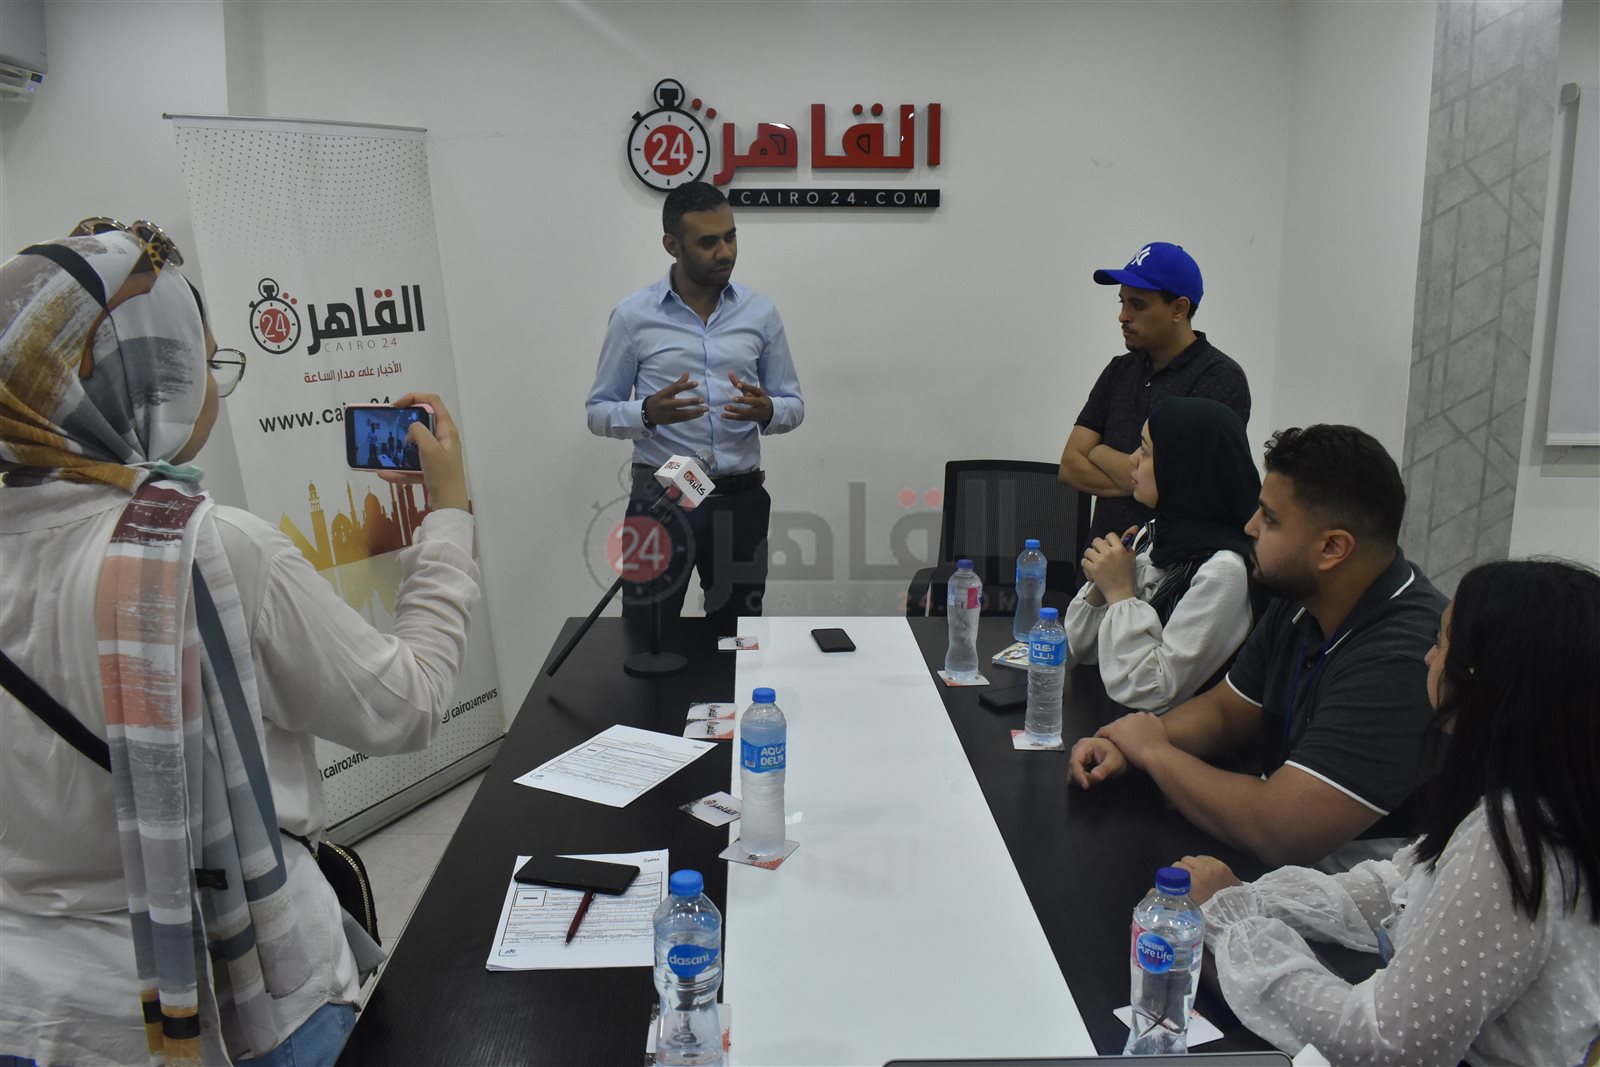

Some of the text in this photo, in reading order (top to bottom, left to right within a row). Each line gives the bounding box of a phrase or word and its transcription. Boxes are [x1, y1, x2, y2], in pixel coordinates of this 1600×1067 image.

[651, 132, 688, 166] 24
[740, 191, 928, 205] CAIRO24.COM
[261, 313, 287, 338] 24
[324, 336, 397, 353] CAIRO 24
[303, 361, 402, 383] الأخبار على مدار الساعة
[451, 688, 498, 718] cairo24news
[669, 952, 710, 966] dasani
[1156, 951, 1173, 963] Life
